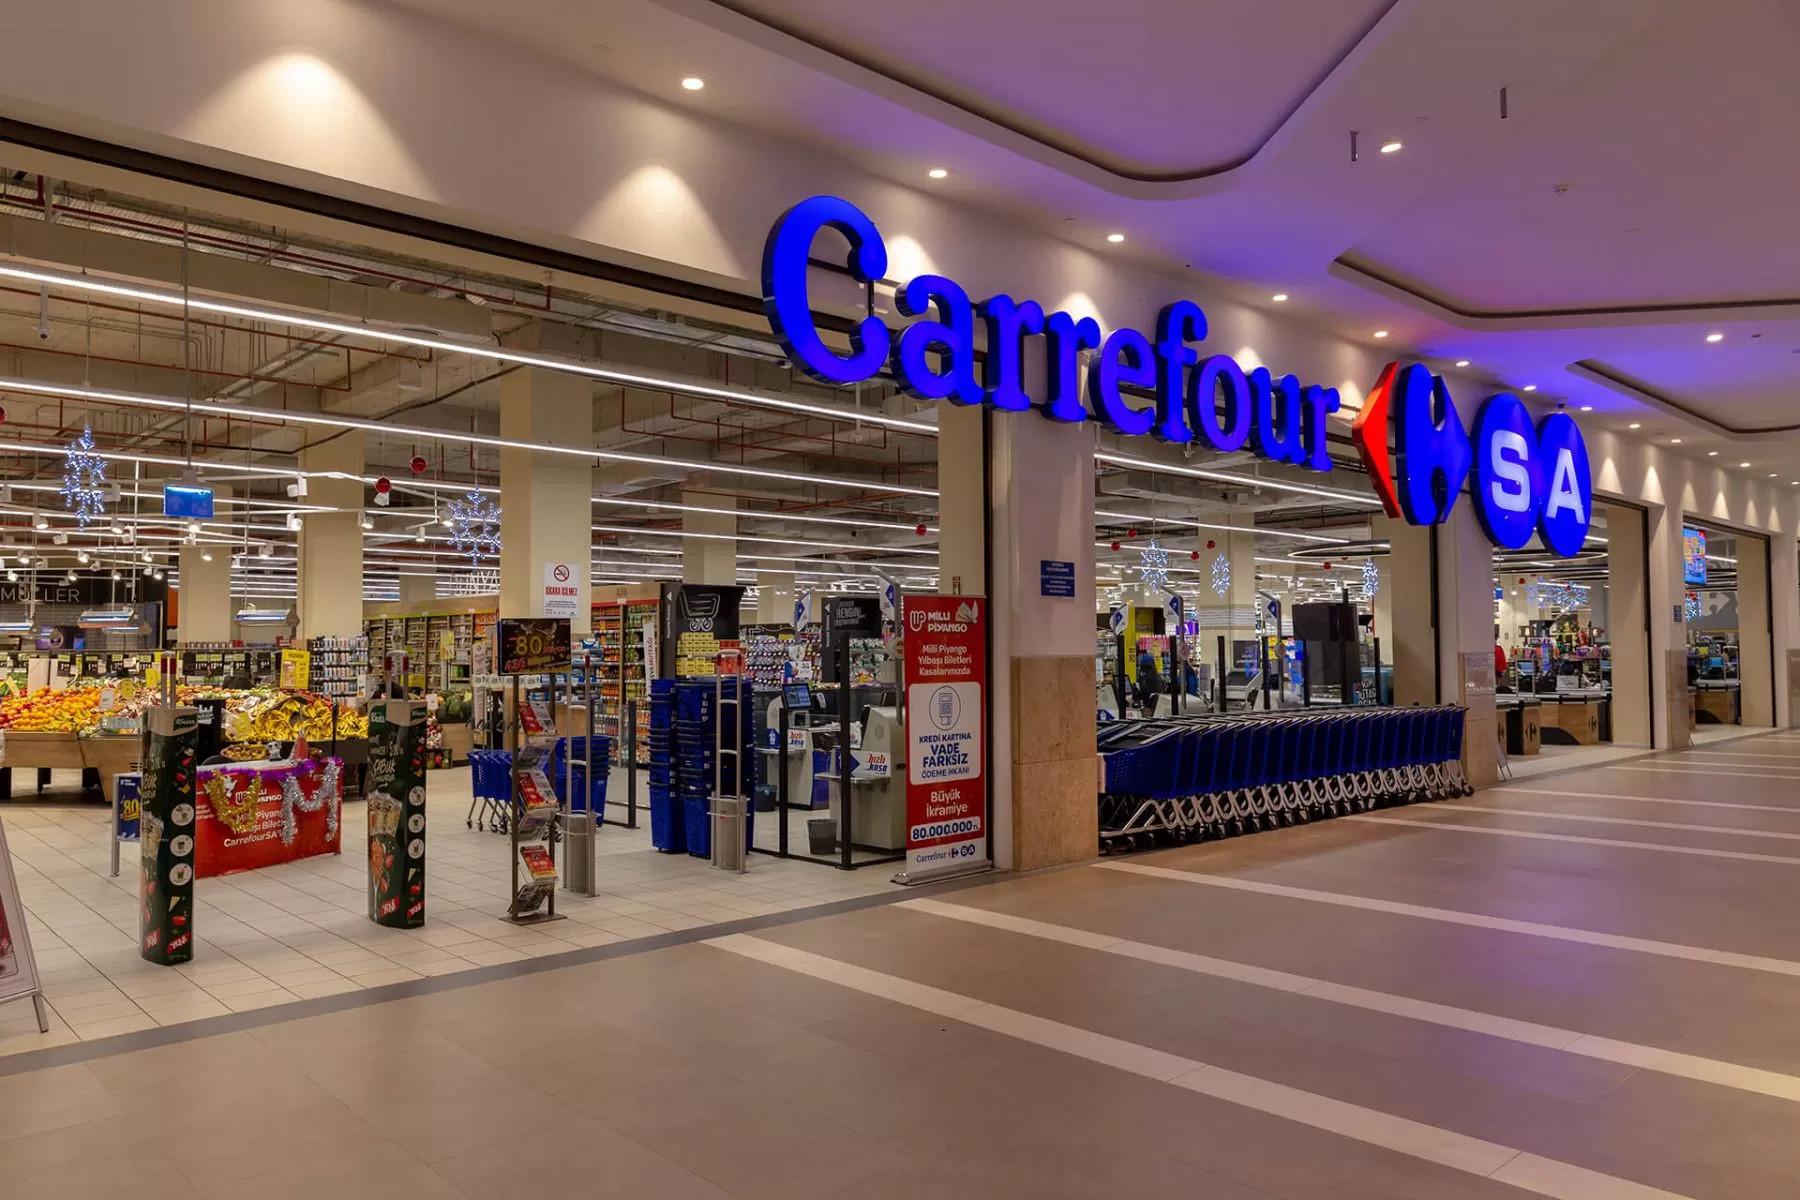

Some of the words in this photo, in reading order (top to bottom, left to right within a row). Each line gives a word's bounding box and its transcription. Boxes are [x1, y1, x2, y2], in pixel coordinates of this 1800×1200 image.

[761, 195, 1340, 472] Carrefour
[1491, 430, 1583, 528] SA
[928, 622, 968, 632] PİYANGO
[922, 644, 938, 653] Milli
[939, 645, 968, 655] Piyango
[918, 655, 943, 666] Yılbaşı
[944, 655, 972, 665] Biletleri
[919, 667, 971, 676] Kasalarımızda
[919, 733, 942, 744] KREDİ
[941, 731, 972, 743] KARTINA
[930, 743, 960, 755] VADE
[922, 753, 968, 769] FARKSIZ
[921, 767, 947, 779] ÖDEME
[931, 788, 961, 803] Büyük
[926, 802, 968, 819] İkramiye
[912, 820, 973, 840] 80.000.000
[916, 849, 947, 864] Carrefour
